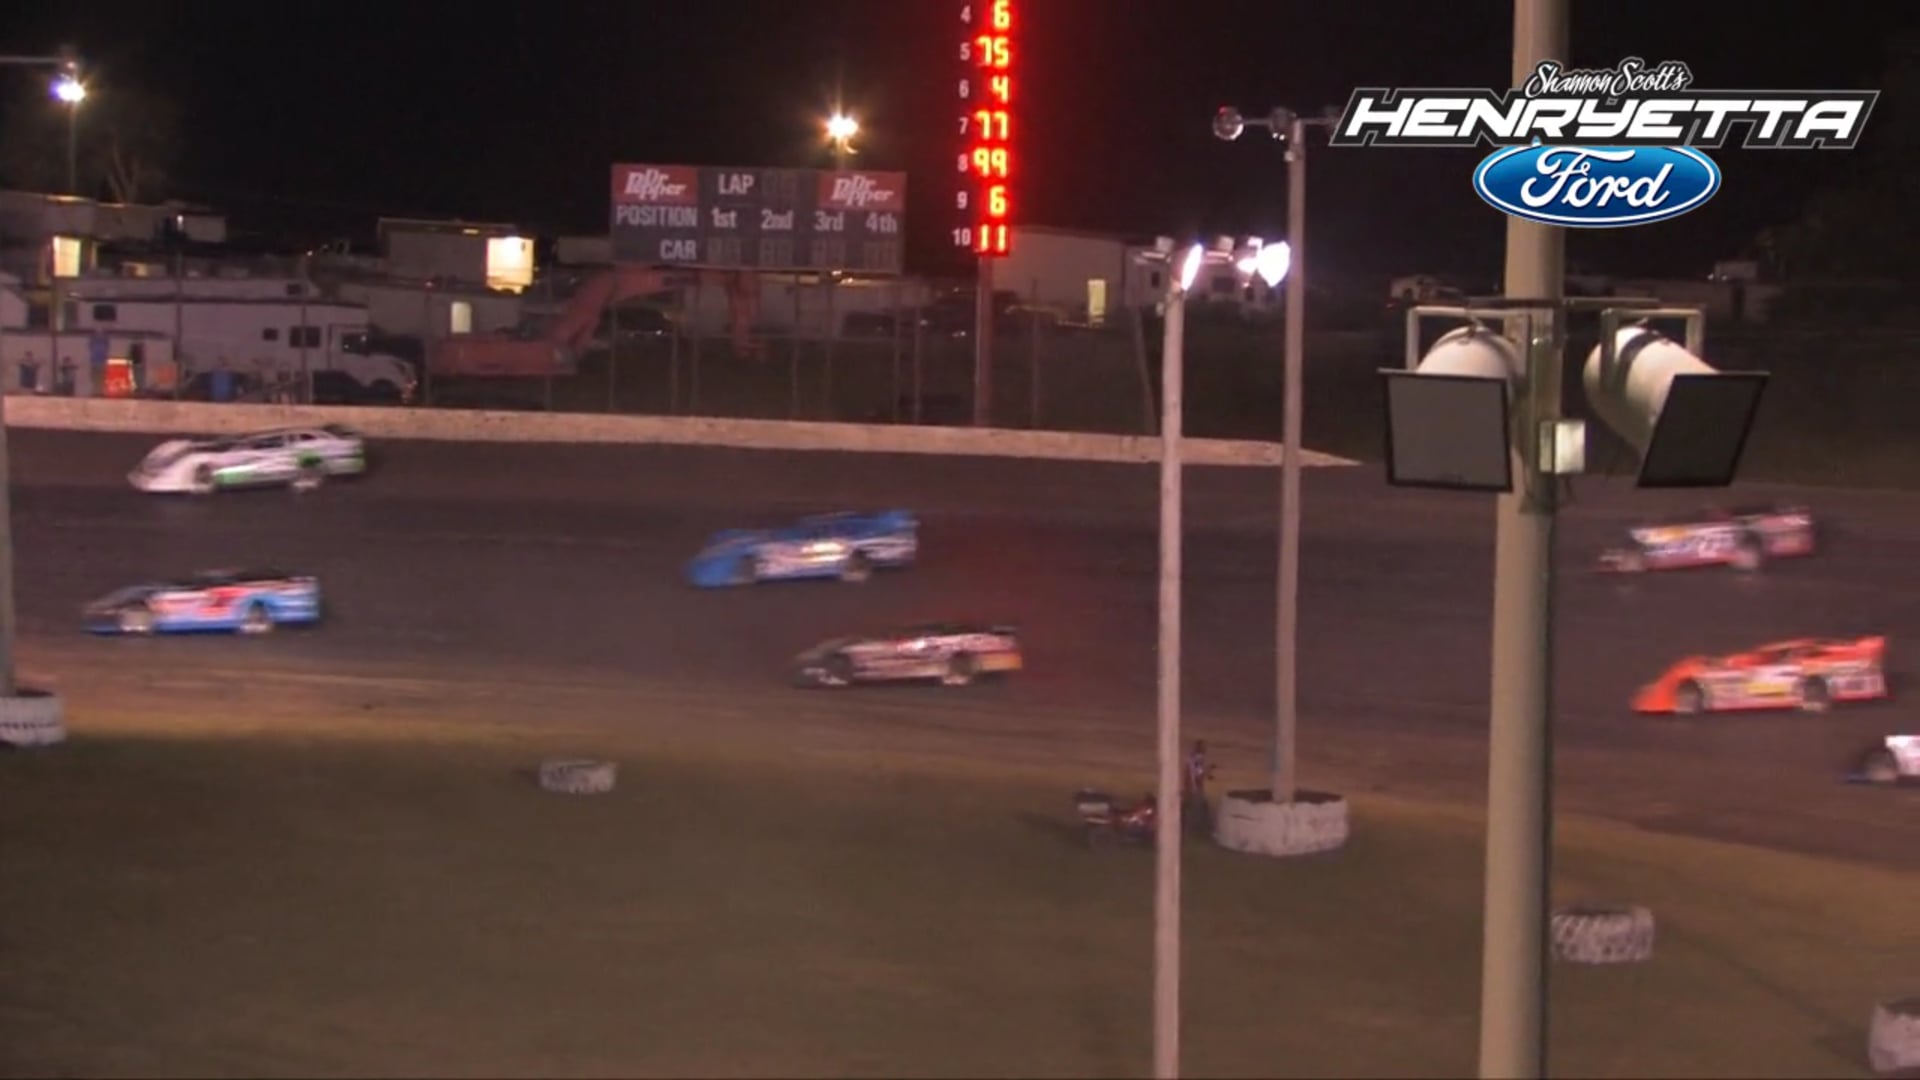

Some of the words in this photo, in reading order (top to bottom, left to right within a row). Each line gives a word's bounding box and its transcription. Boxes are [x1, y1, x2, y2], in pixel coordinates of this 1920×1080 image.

[960, 6, 971, 23] 4
[992, 0, 1010, 29] 6
[960, 42, 971, 61] 5
[976, 36, 1010, 67] 75
[959, 79, 970, 98] 6
[992, 75, 1010, 104] 4
[959, 117, 969, 135] 7
[974, 110, 1009, 140] 77
[958, 153, 969, 172] 8
[973, 147, 1008, 178] 99
[718, 173, 755, 195] LAP
[957, 191, 968, 209] 9
[989, 185, 1006, 216] 6
[616, 205, 698, 227] POSITION
[711, 207, 738, 229] 1st
[761, 209, 794, 231] 2nd
[814, 210, 845, 232] 3rd
[865, 211, 898, 233] 4th
[660, 239, 697, 260] CAR
[953, 228, 971, 246] 10
[980, 224, 1006, 252] 11
